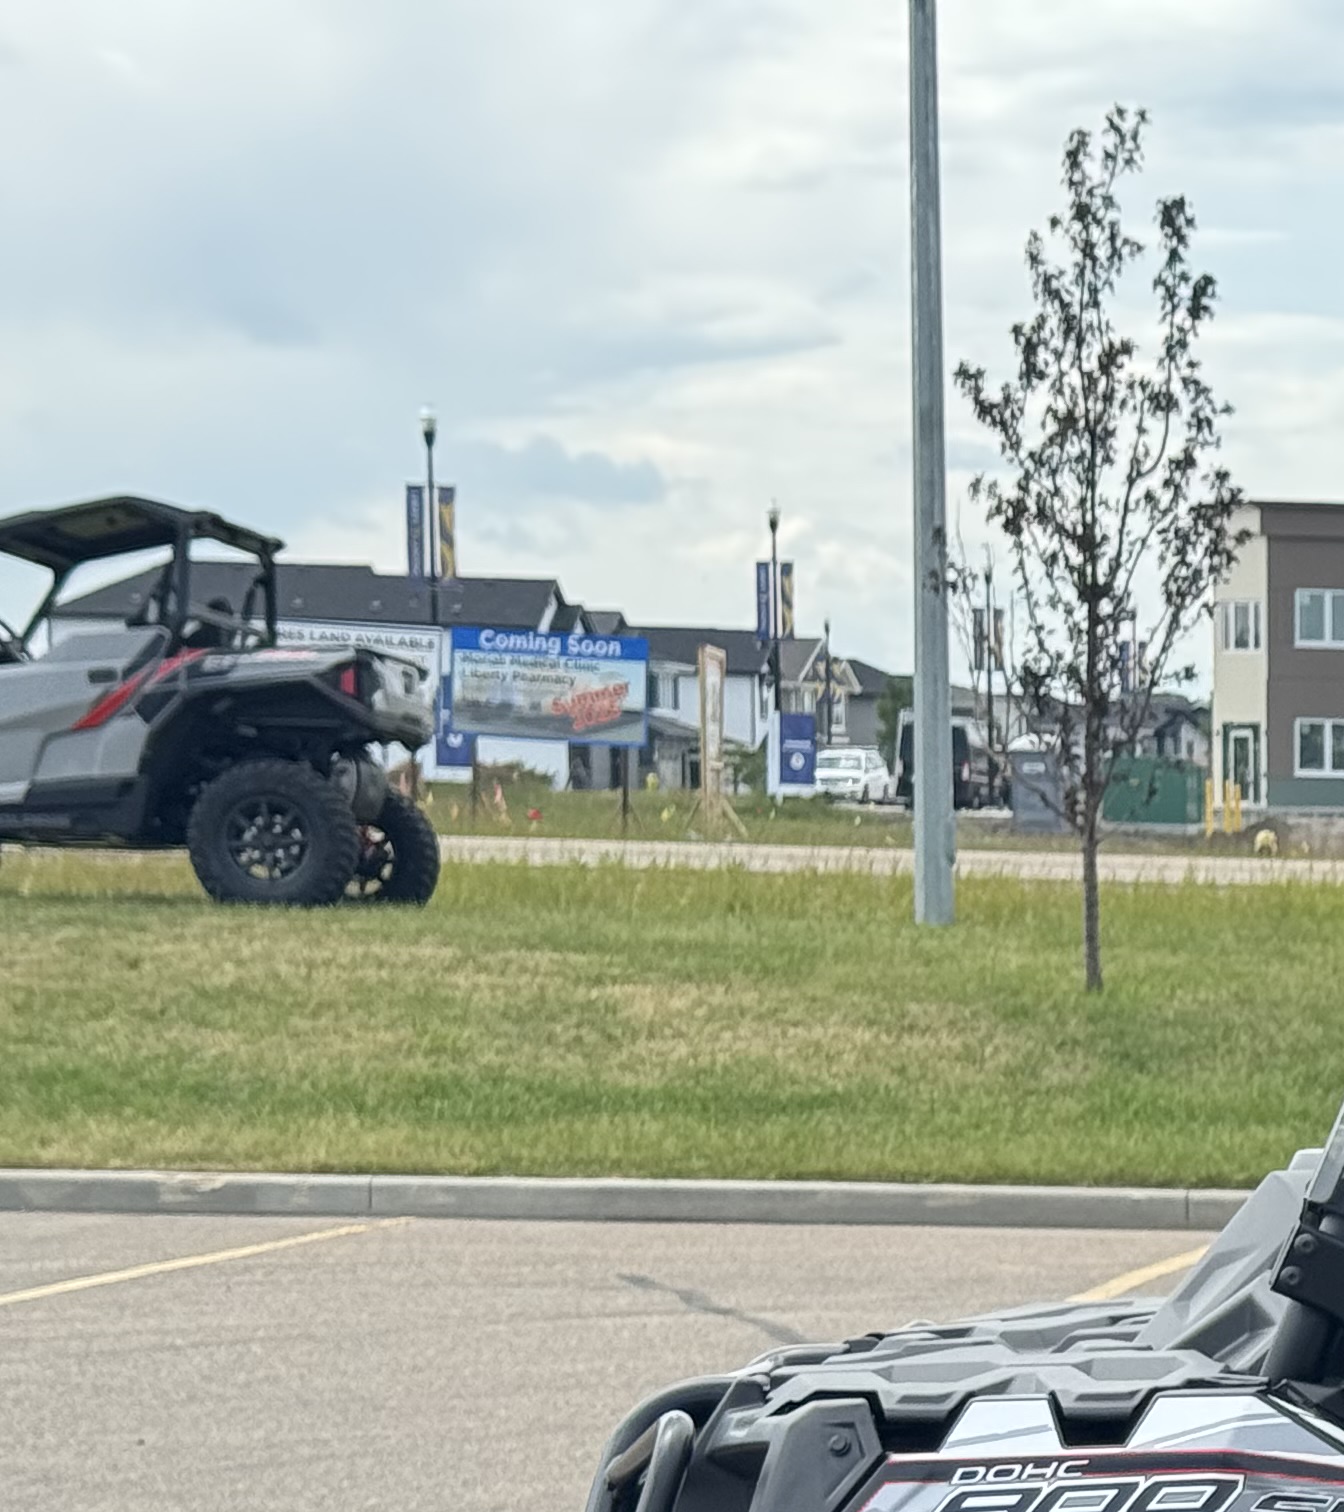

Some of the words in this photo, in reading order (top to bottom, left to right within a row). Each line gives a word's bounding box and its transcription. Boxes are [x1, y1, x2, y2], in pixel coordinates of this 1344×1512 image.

[309, 629, 350, 643] LAND
[355, 632, 436, 649] AVAILABLE
[478, 629, 562, 657] Coming
[567, 634, 622, 657] Soon
[463, 665, 507, 682] Liberty
[512, 670, 577, 687] Pharmacy
[564, 658, 600, 672] Clinic
[551, 682, 630, 716] Summer
[949, 1459, 1091, 1486] DOHC
